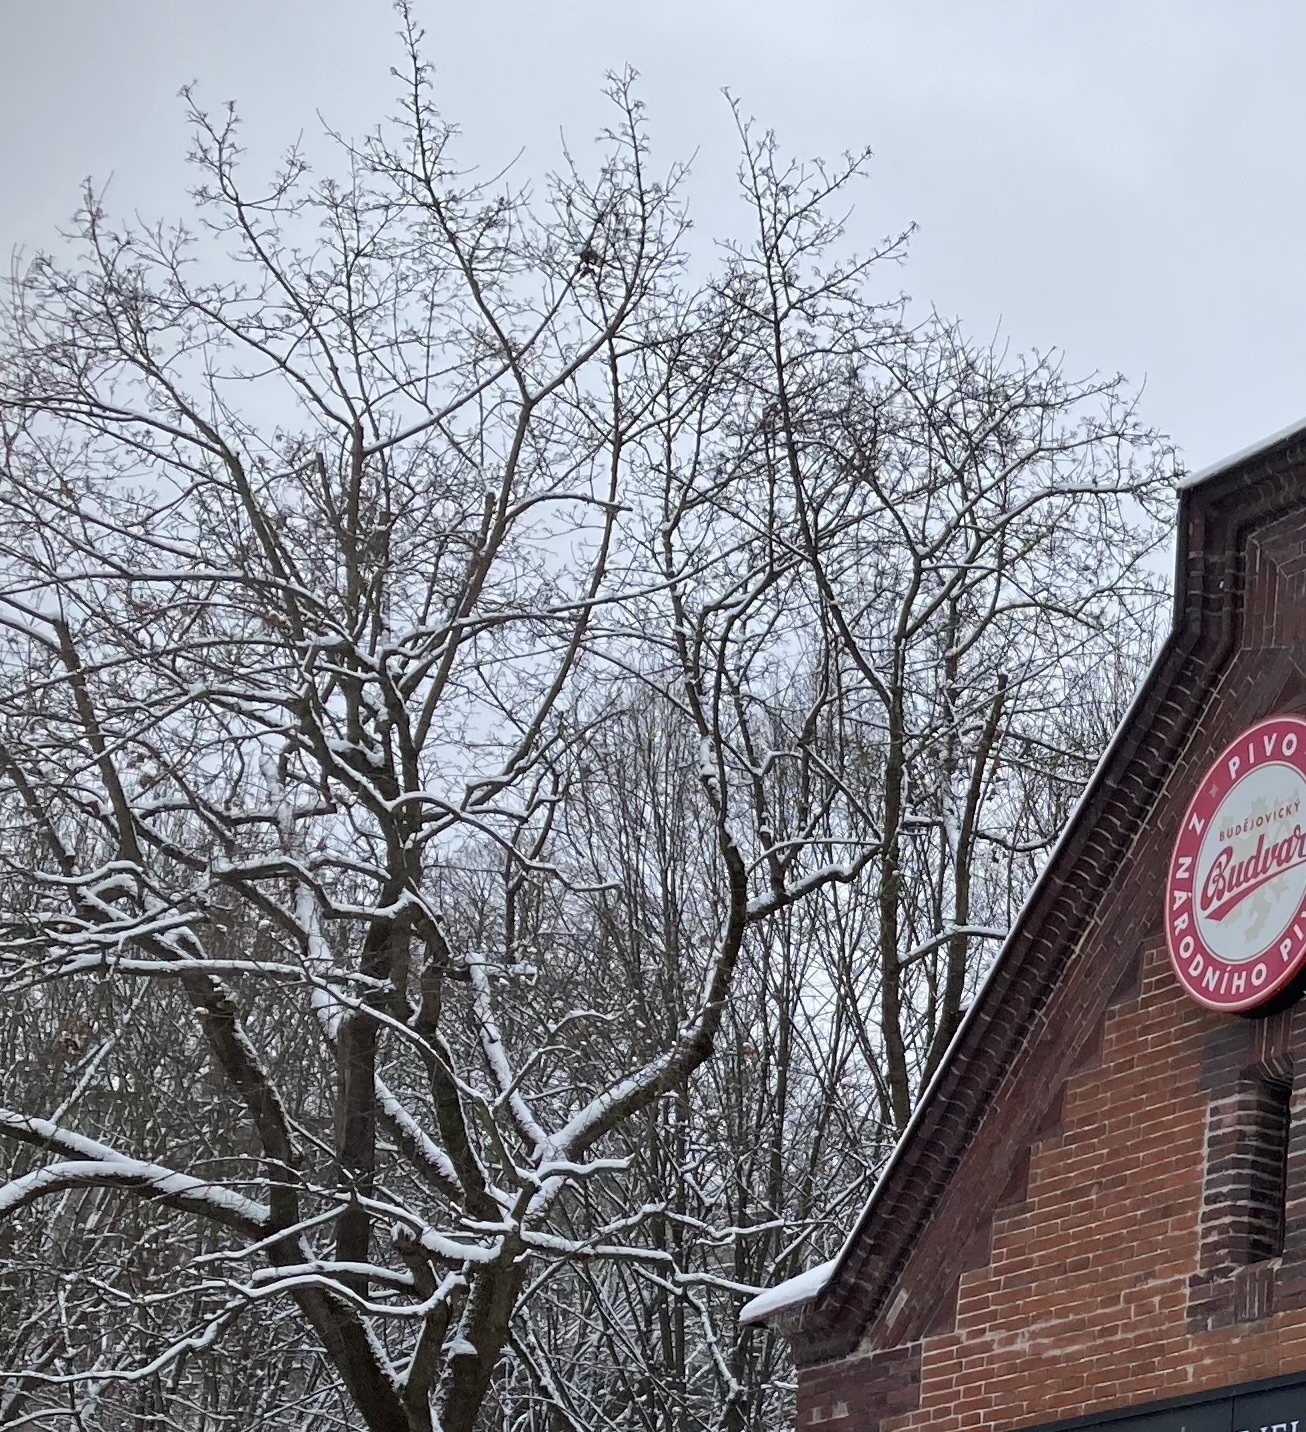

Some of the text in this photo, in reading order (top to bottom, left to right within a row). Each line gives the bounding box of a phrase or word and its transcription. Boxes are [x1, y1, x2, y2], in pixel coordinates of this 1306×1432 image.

[1227, 732, 1298, 781] PIVO
[1188, 811, 1205, 837] Z
[1218, 800, 1301, 842] BUDĚJOVICKÝ
[1173, 856, 1268, 995] NÁRODNÍHO
